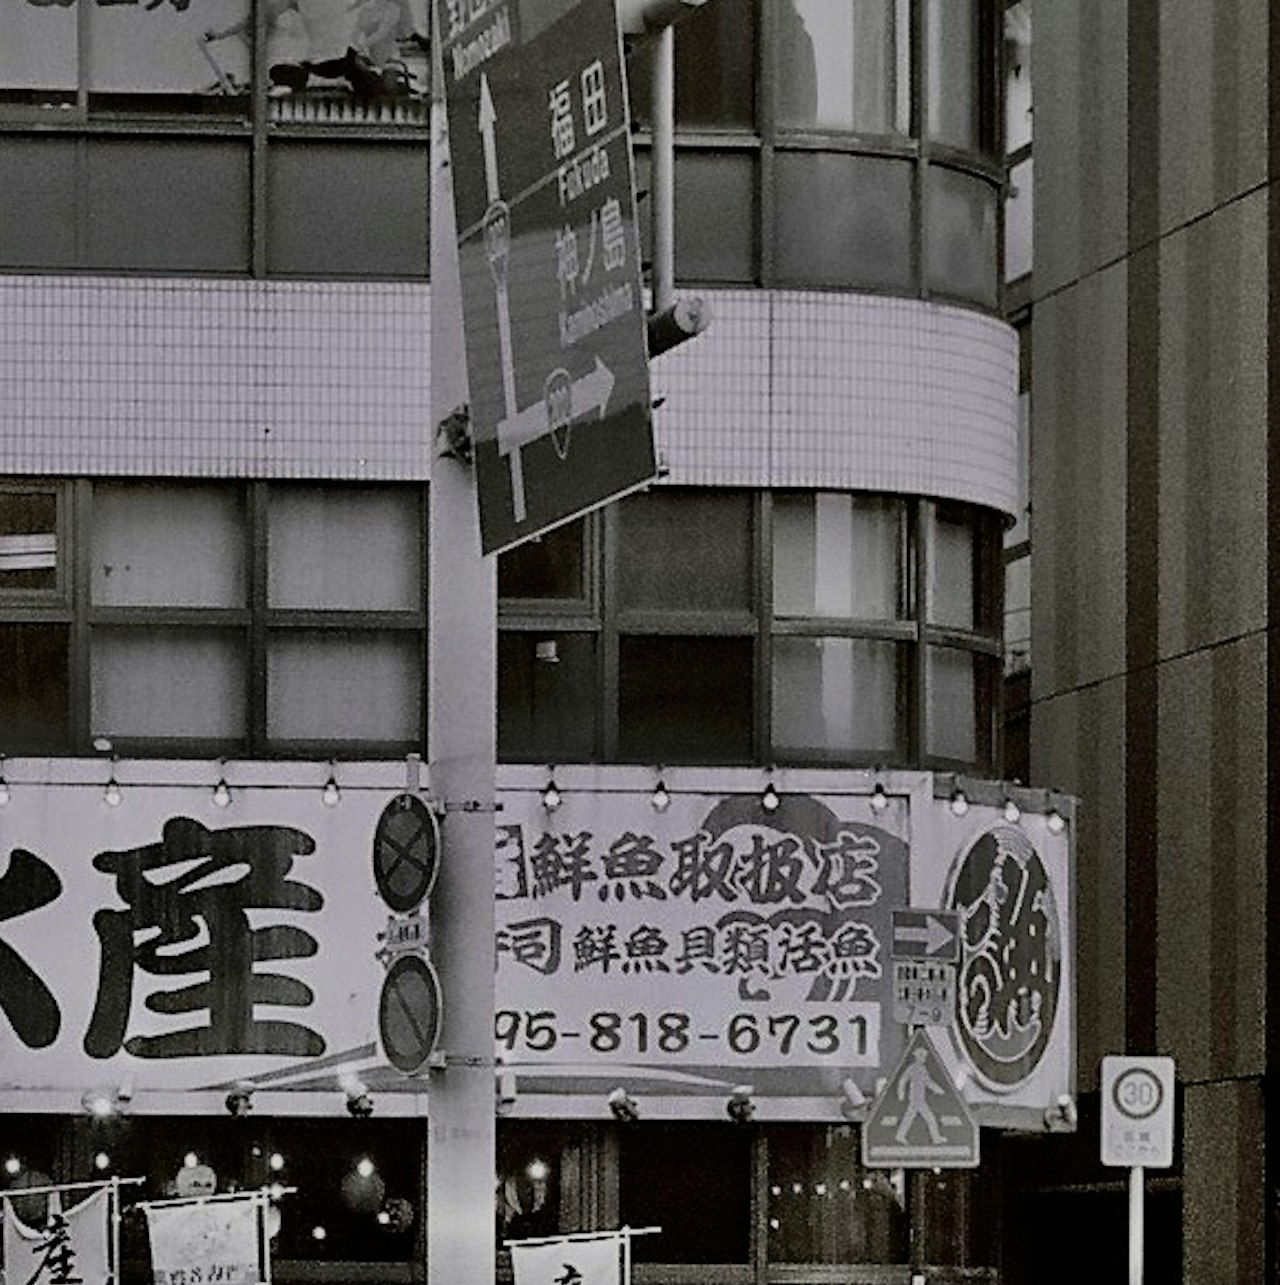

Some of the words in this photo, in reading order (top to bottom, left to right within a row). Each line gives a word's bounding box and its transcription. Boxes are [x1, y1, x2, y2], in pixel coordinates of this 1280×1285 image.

[549, 59, 608, 160] 福田
[555, 196, 626, 296] 神ノ島
[495, 916, 562, 975] 司
[571, 922, 879, 976] 鮮魚貝類活魚
[1123, 1080, 1154, 1106] 30
